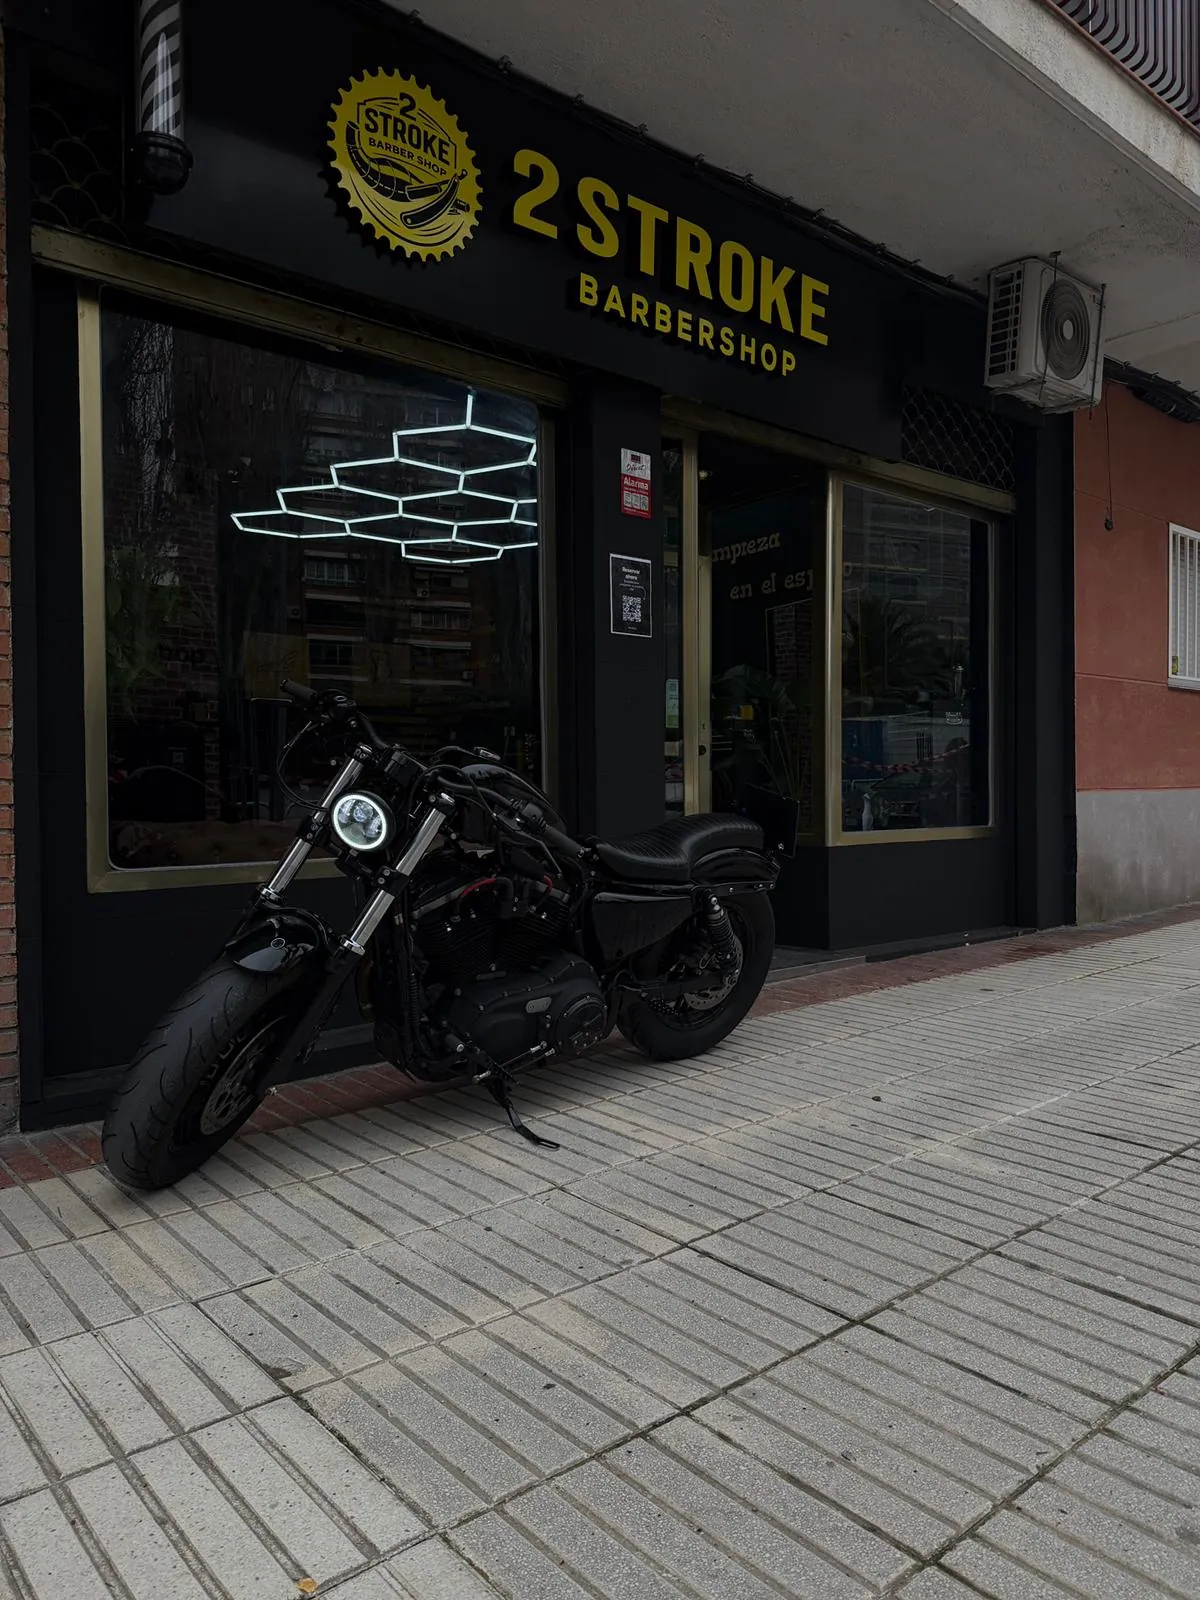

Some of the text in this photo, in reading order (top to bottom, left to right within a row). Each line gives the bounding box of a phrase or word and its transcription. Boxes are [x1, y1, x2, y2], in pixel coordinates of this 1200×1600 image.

[399, 92, 417, 122] 2
[364, 108, 450, 166] STROKE
[368, 137, 447, 177] BARBER SHOP
[513, 148, 831, 346] 2 STROKE
[579, 272, 797, 377] BARBERSHOP
[623, 475, 649, 491] Alarma
[729, 583, 753, 600] en
[761, 571, 777, 594] el
